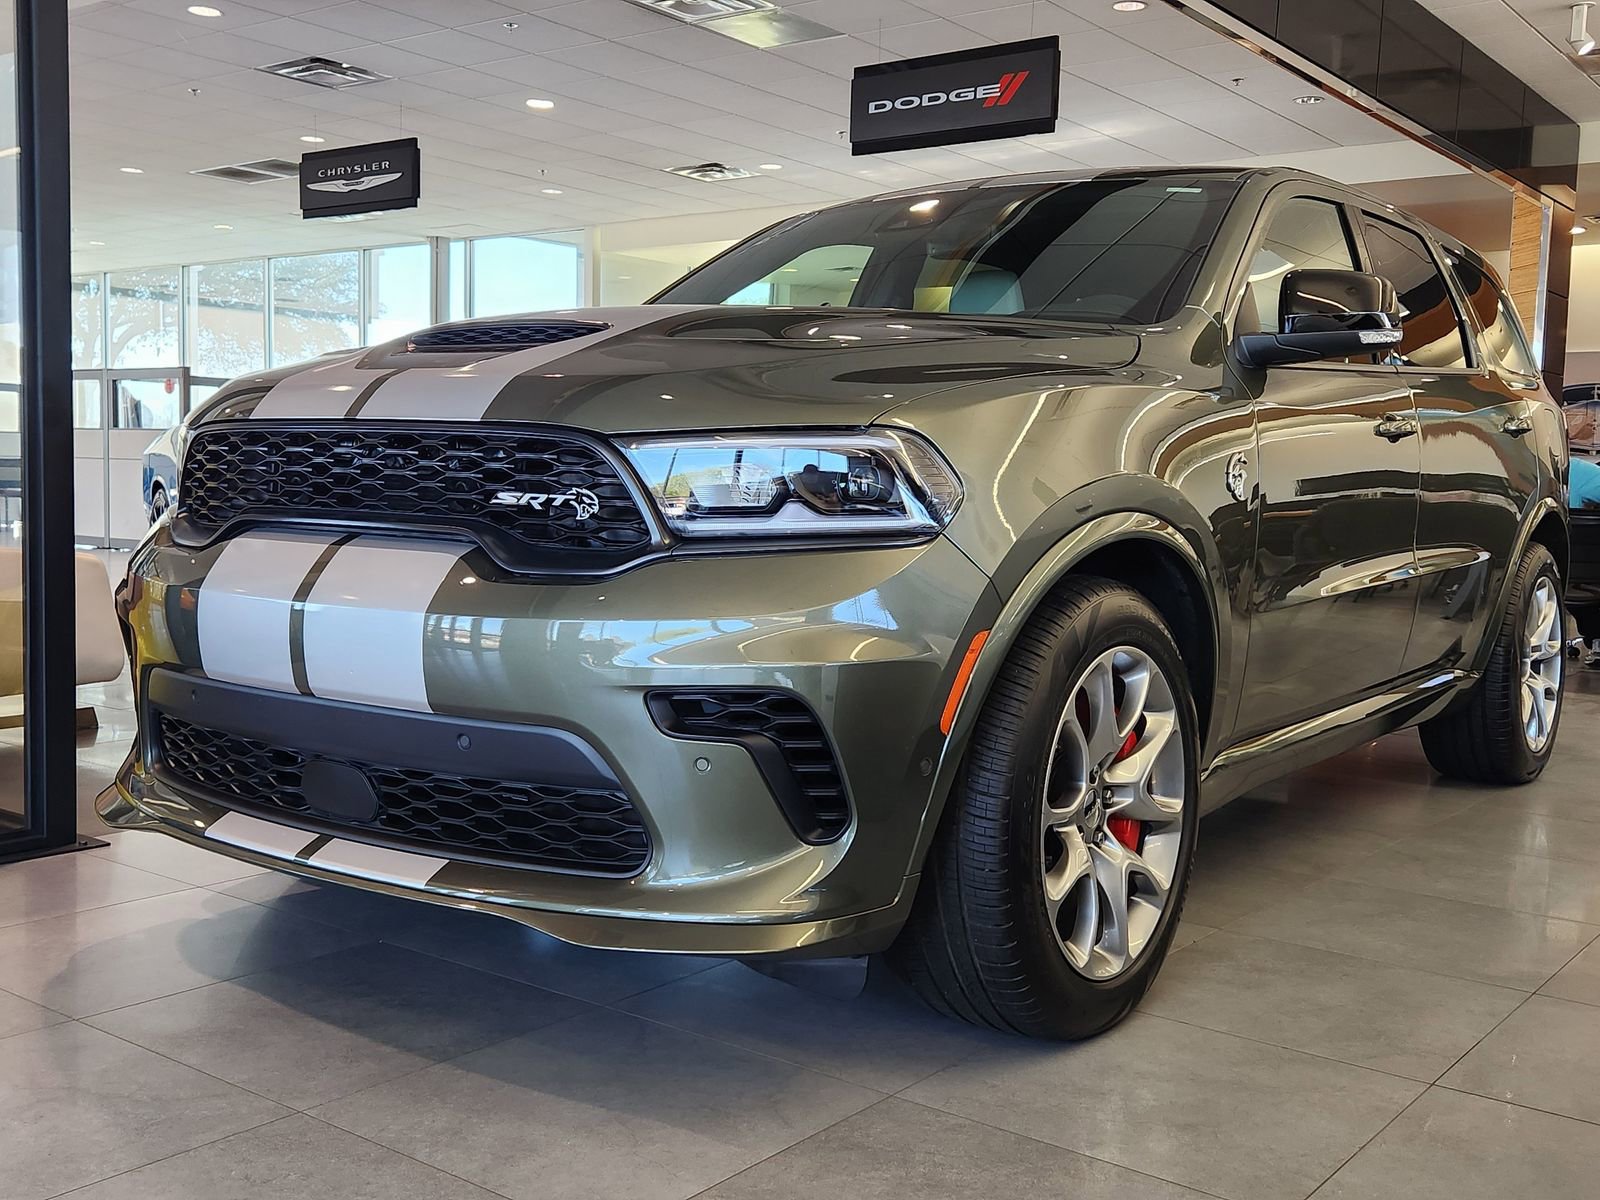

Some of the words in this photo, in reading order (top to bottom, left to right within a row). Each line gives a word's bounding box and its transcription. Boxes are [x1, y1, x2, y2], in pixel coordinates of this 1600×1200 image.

[868, 84, 1001, 114] DODGE
[318, 161, 390, 177] CHRYSLER
[489, 492, 577, 510] SRT
